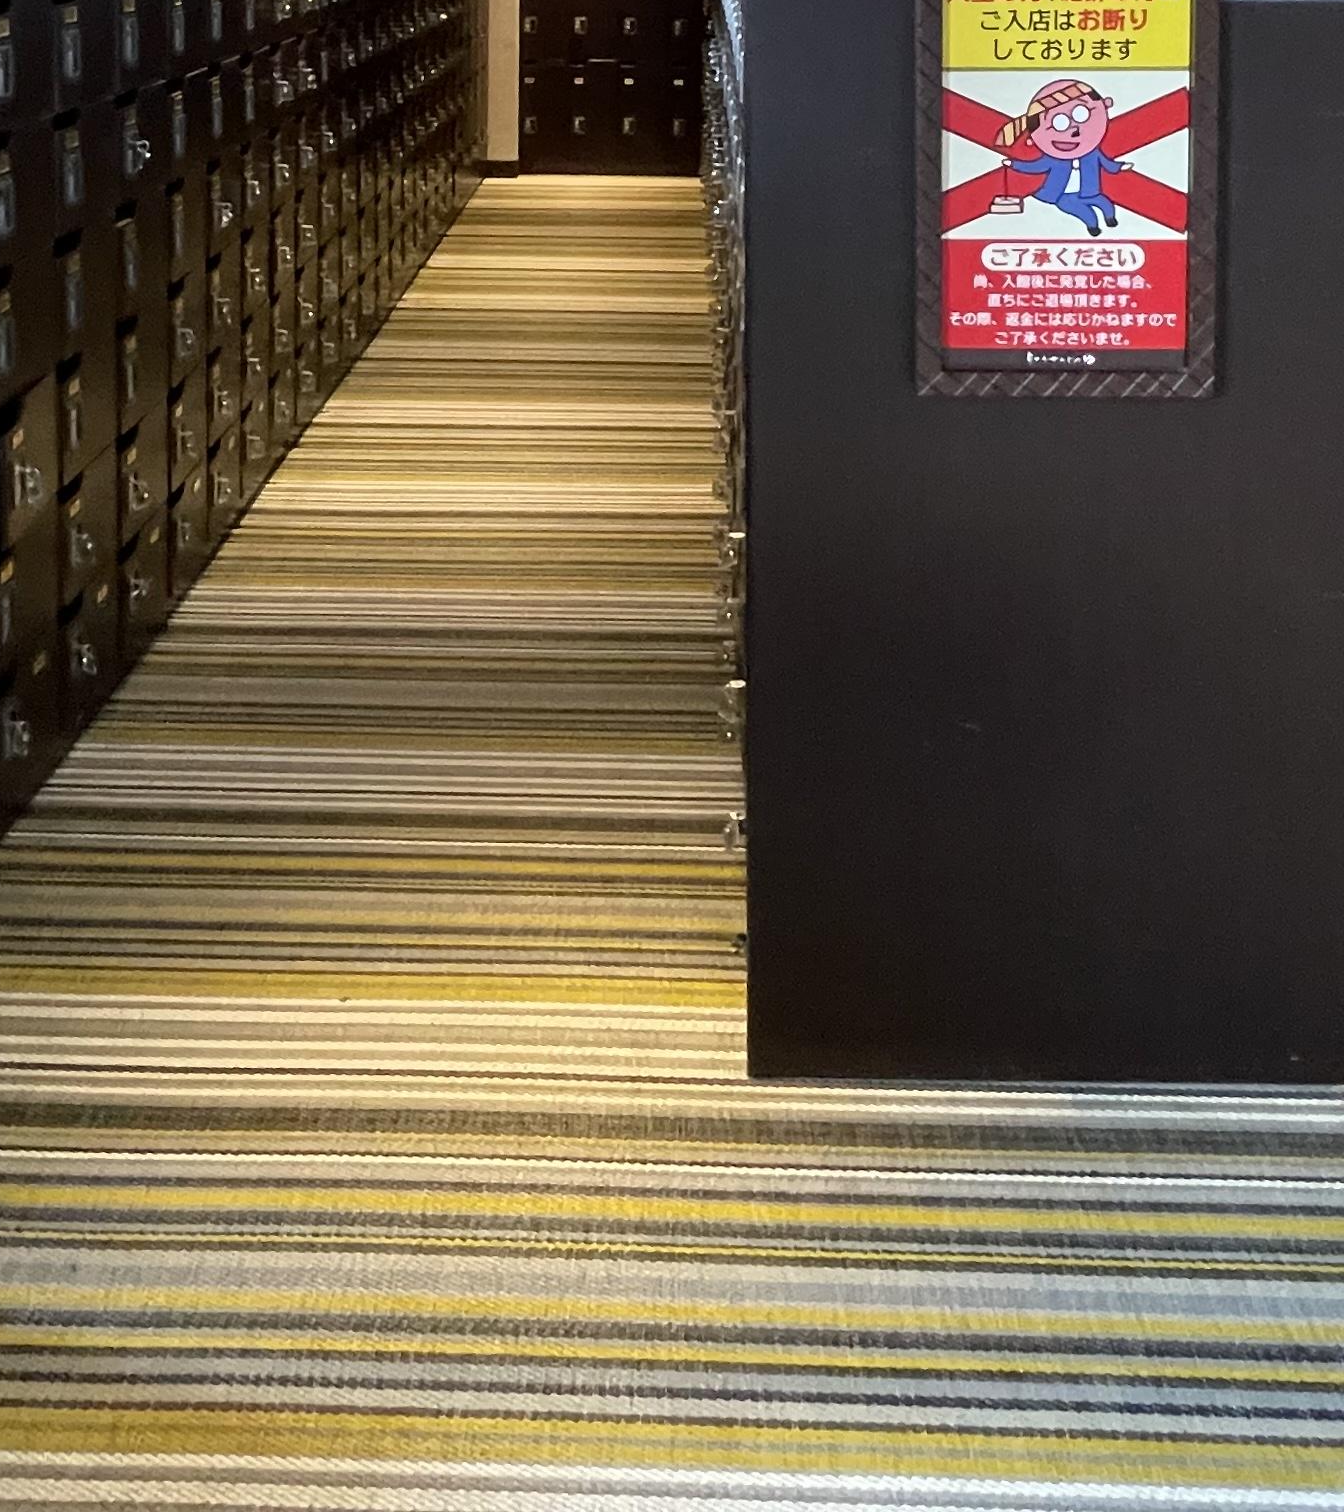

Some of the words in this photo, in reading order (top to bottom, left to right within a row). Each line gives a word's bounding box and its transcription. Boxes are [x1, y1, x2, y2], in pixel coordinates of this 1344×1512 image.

[980, 8, 1148, 32] ご入店はお断り
[993, 38, 1137, 61] しております
[990, 248, 1138, 268] ご了承ください
[987, 293, 1138, 308] 直ちにご退場頂きます。
[949, 312, 1177, 327] その際、返金には応じかねますので
[994, 331, 1130, 345] ご了承くださいませ。
